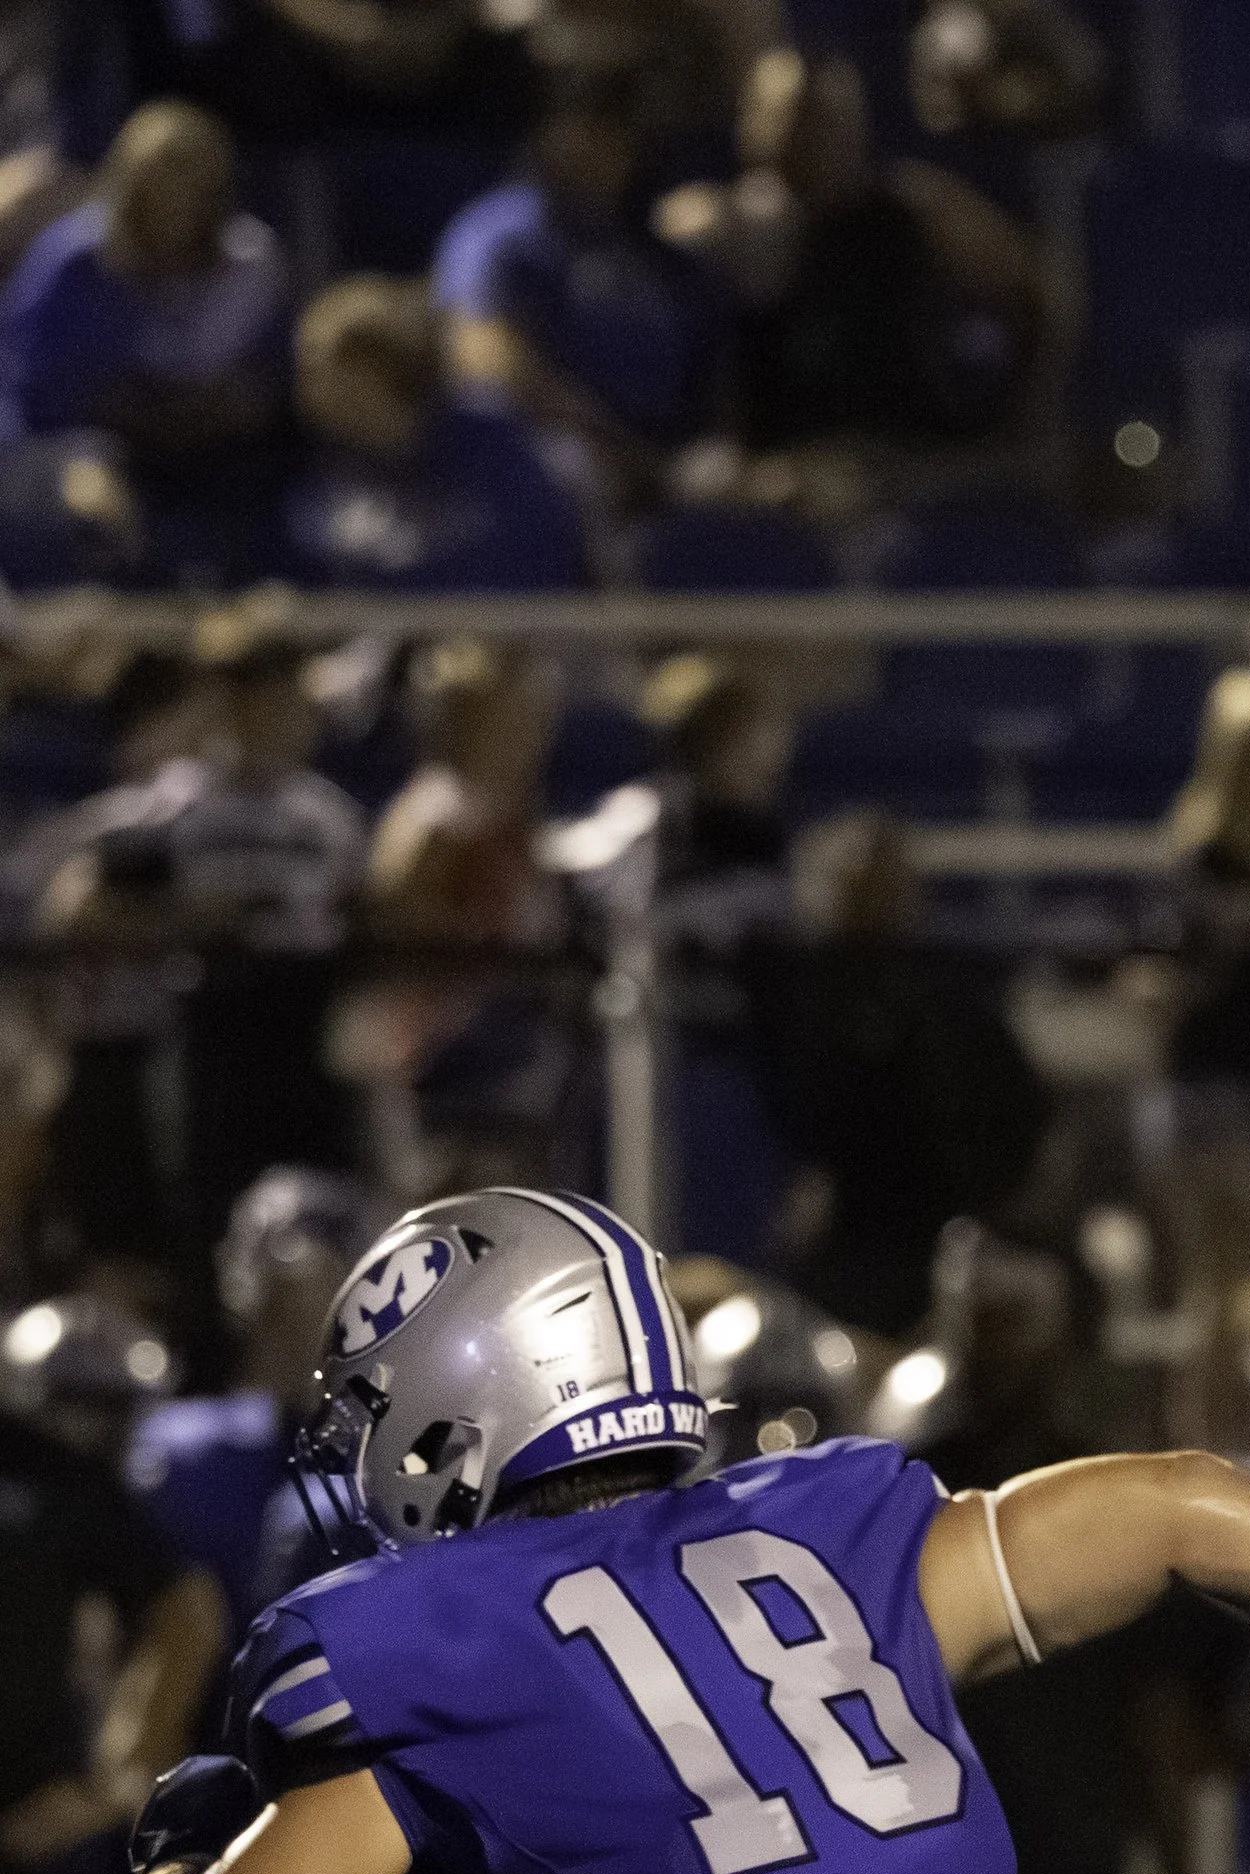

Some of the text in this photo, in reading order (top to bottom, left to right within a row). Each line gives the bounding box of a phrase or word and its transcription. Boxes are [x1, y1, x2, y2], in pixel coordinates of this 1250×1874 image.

[341, 1241, 436, 1353] M
[557, 1380, 580, 1401] 18
[566, 1403, 665, 1453] HARD
